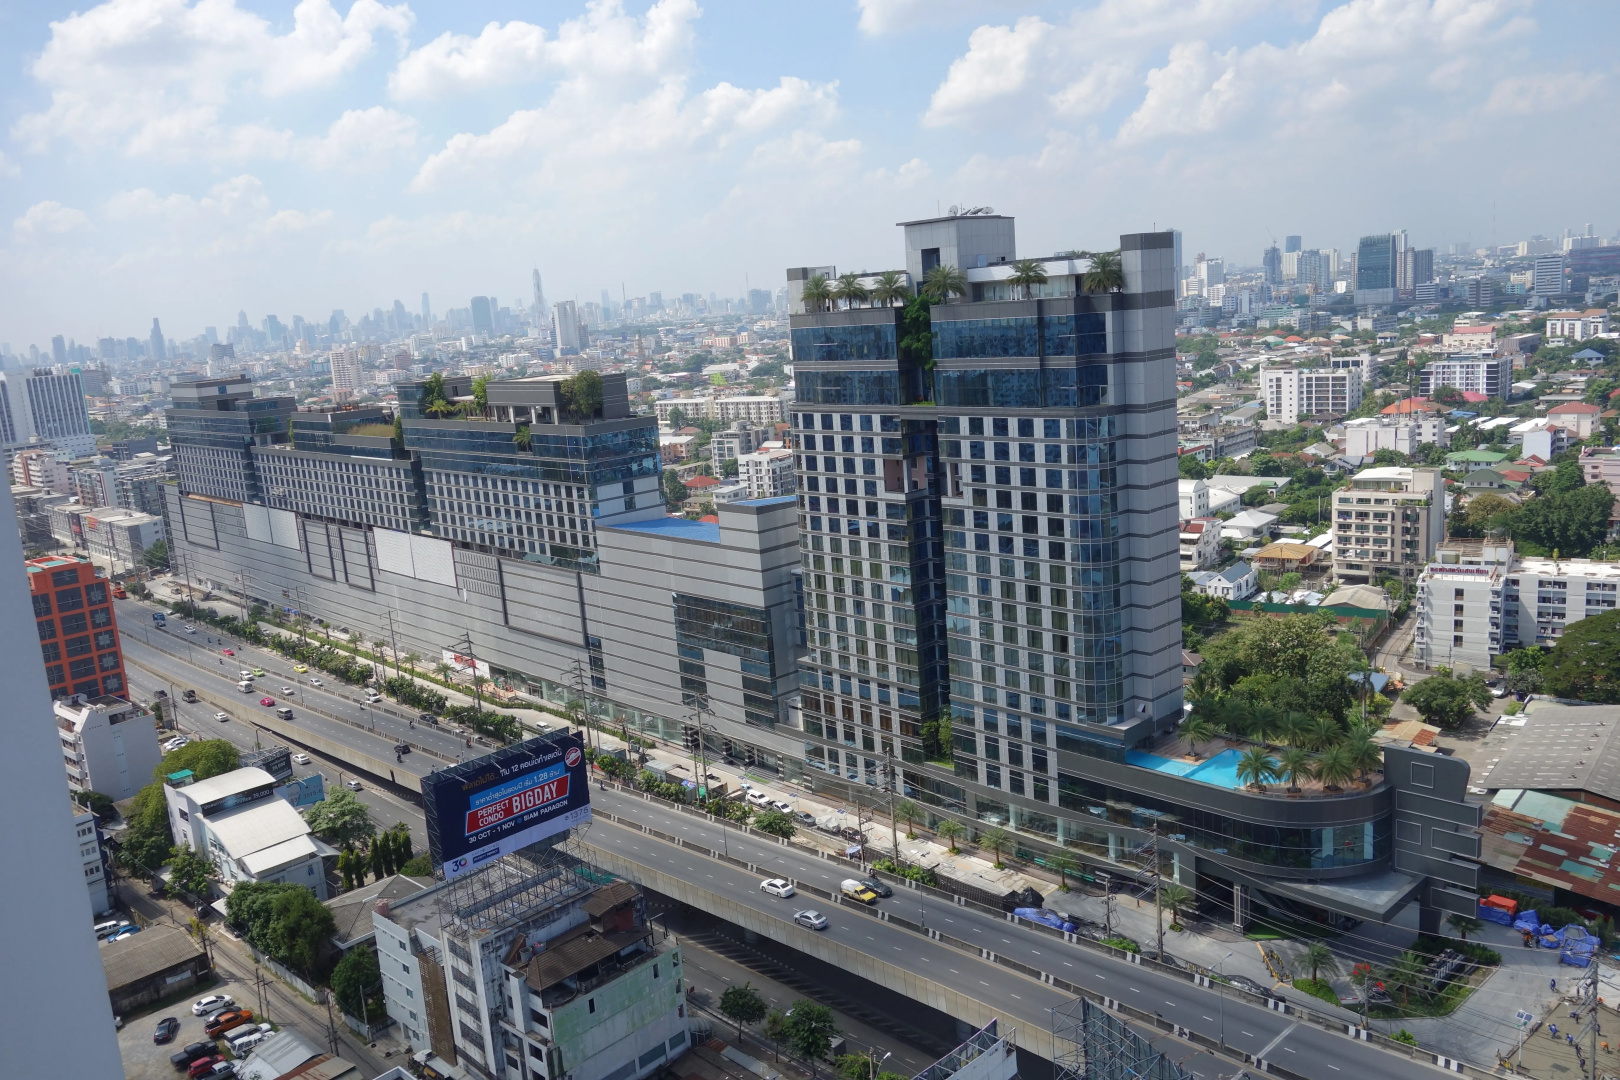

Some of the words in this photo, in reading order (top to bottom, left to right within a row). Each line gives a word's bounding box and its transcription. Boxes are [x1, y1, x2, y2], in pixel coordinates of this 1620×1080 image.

[512, 782, 558, 814] BIGDAY
[478, 800, 509, 818] PERFECT
[479, 811, 504, 827] CONDO
[524, 812, 539, 822] SIAM
[541, 799, 568, 816] PARAGON
[478, 830, 491, 840] OCT
[502, 820, 515, 830] NOV
